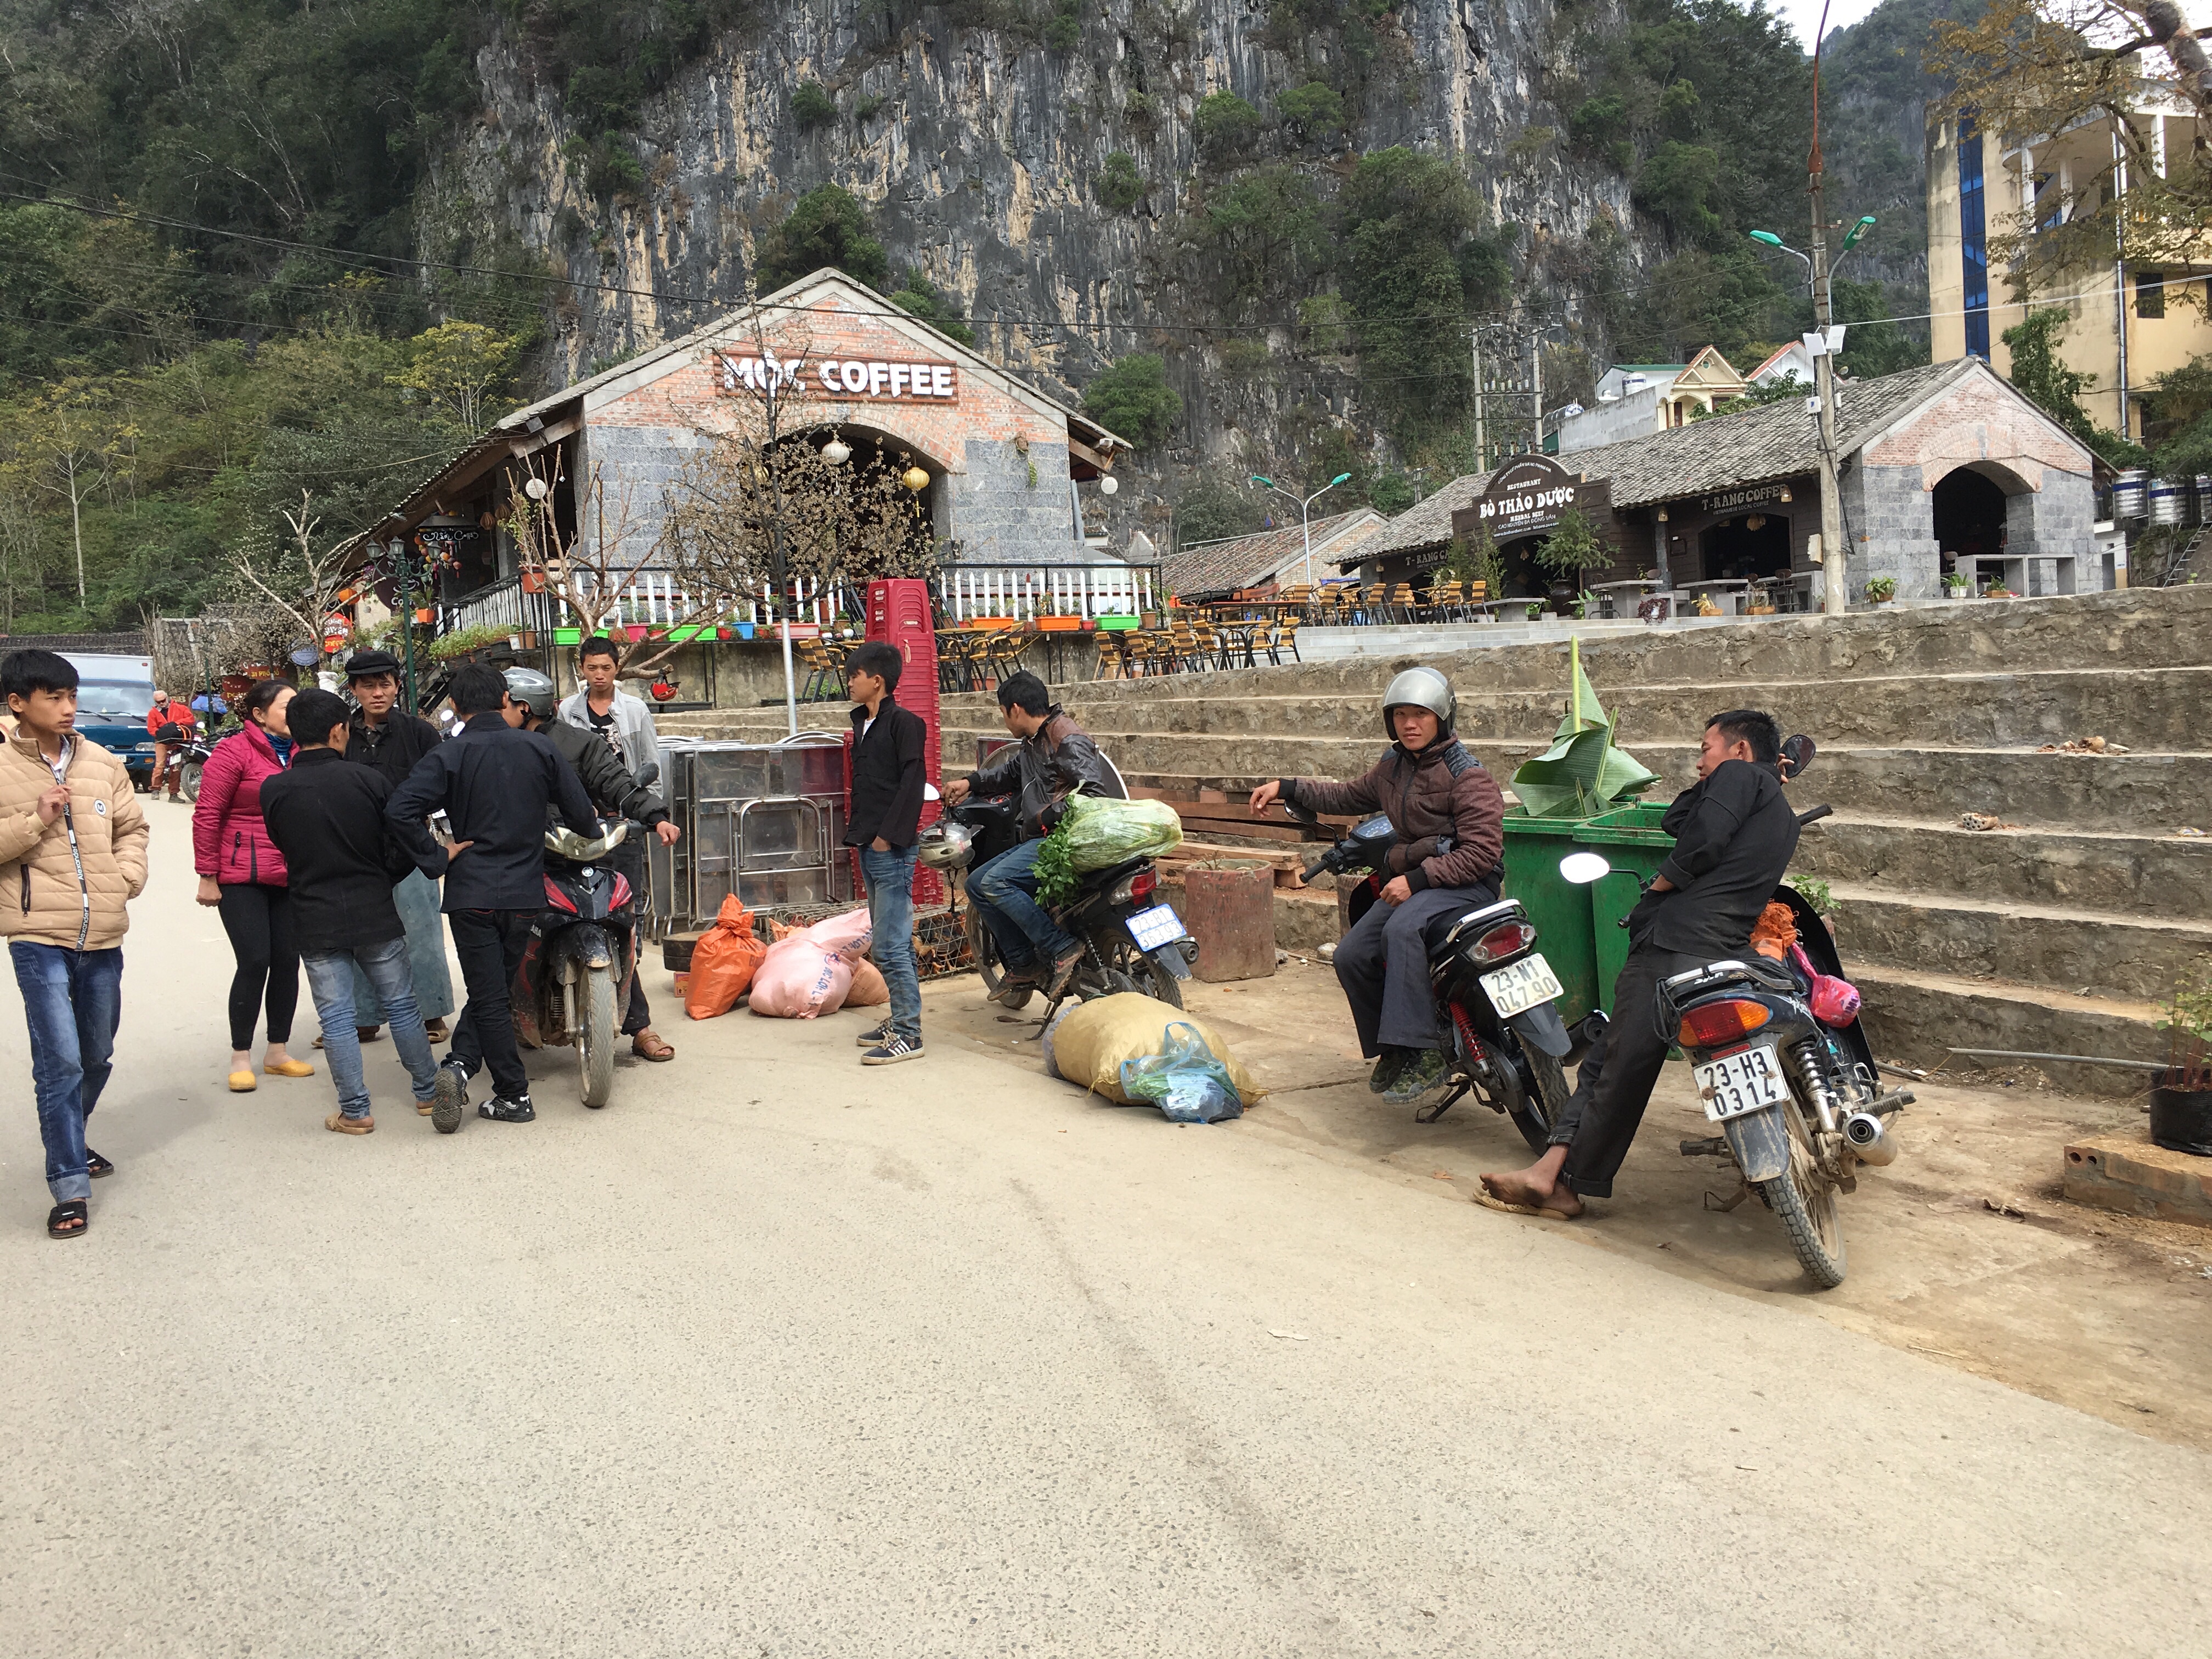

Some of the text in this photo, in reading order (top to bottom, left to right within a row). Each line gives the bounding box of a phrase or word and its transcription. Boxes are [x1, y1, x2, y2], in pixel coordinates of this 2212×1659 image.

[819, 360, 954, 398] COFFEE
[1479, 486, 1575, 518] BÒ THẢO DƯỢC
[1506, 478, 1541, 491] RESTAURANT
[1510, 513, 1531, 522] HERBAL
[72, 844, 84, 881] Alexander
[77, 908, 89, 946] Alexander
[1492, 961, 1540, 992] 23-N1
[1703, 1052, 1769, 1091] 23-H3
[1713, 1077, 1776, 1116] 0314
